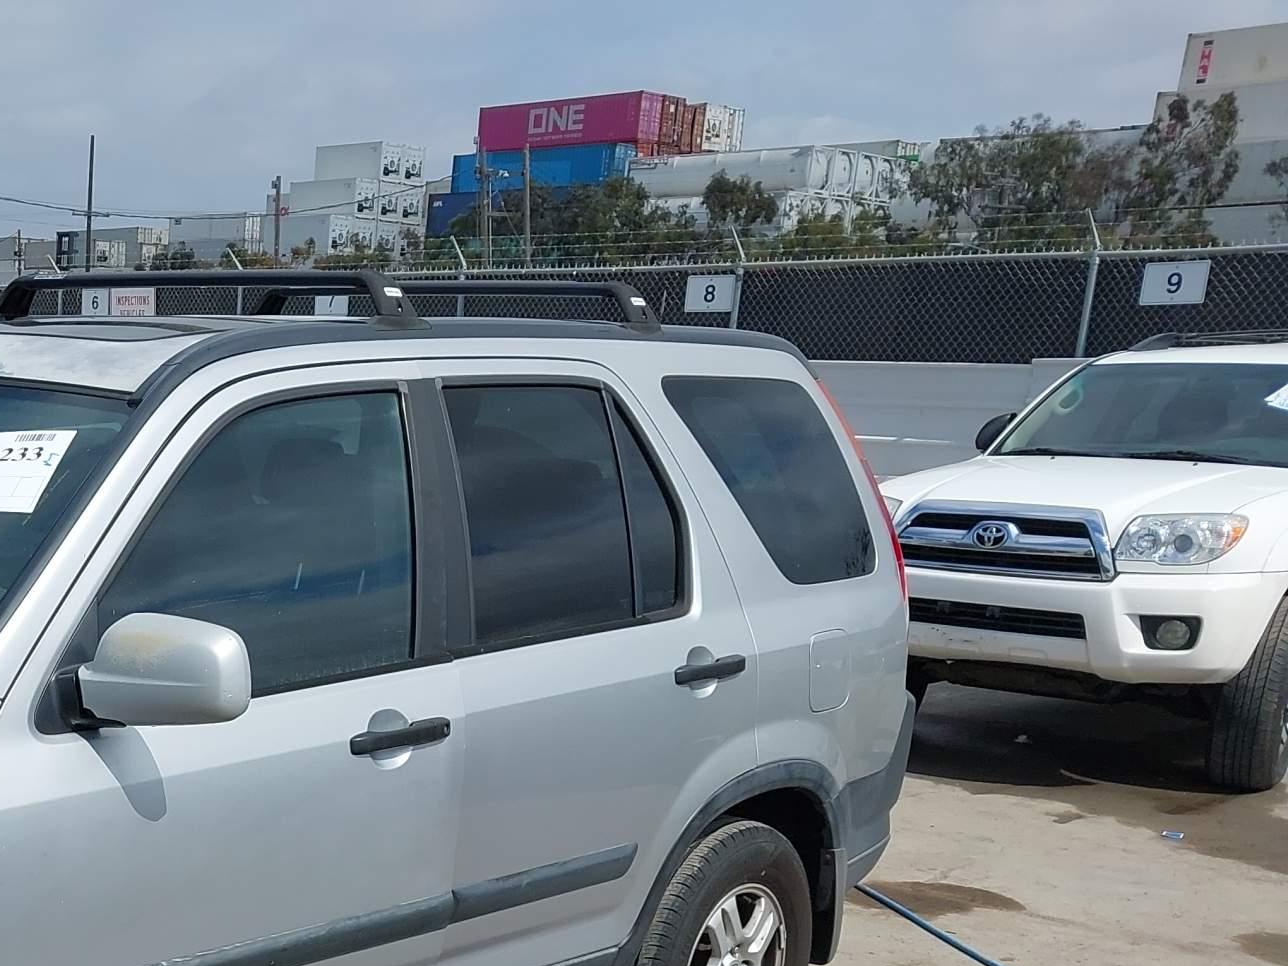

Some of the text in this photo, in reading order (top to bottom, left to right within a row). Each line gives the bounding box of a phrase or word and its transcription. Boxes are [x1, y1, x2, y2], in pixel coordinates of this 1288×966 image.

[528, 104, 586, 134] ONE
[1166, 272, 1183, 294] 9
[91, 295, 99, 310] 6
[115, 295, 150, 306] INSPECTIONS
[703, 284, 716, 303] 8
